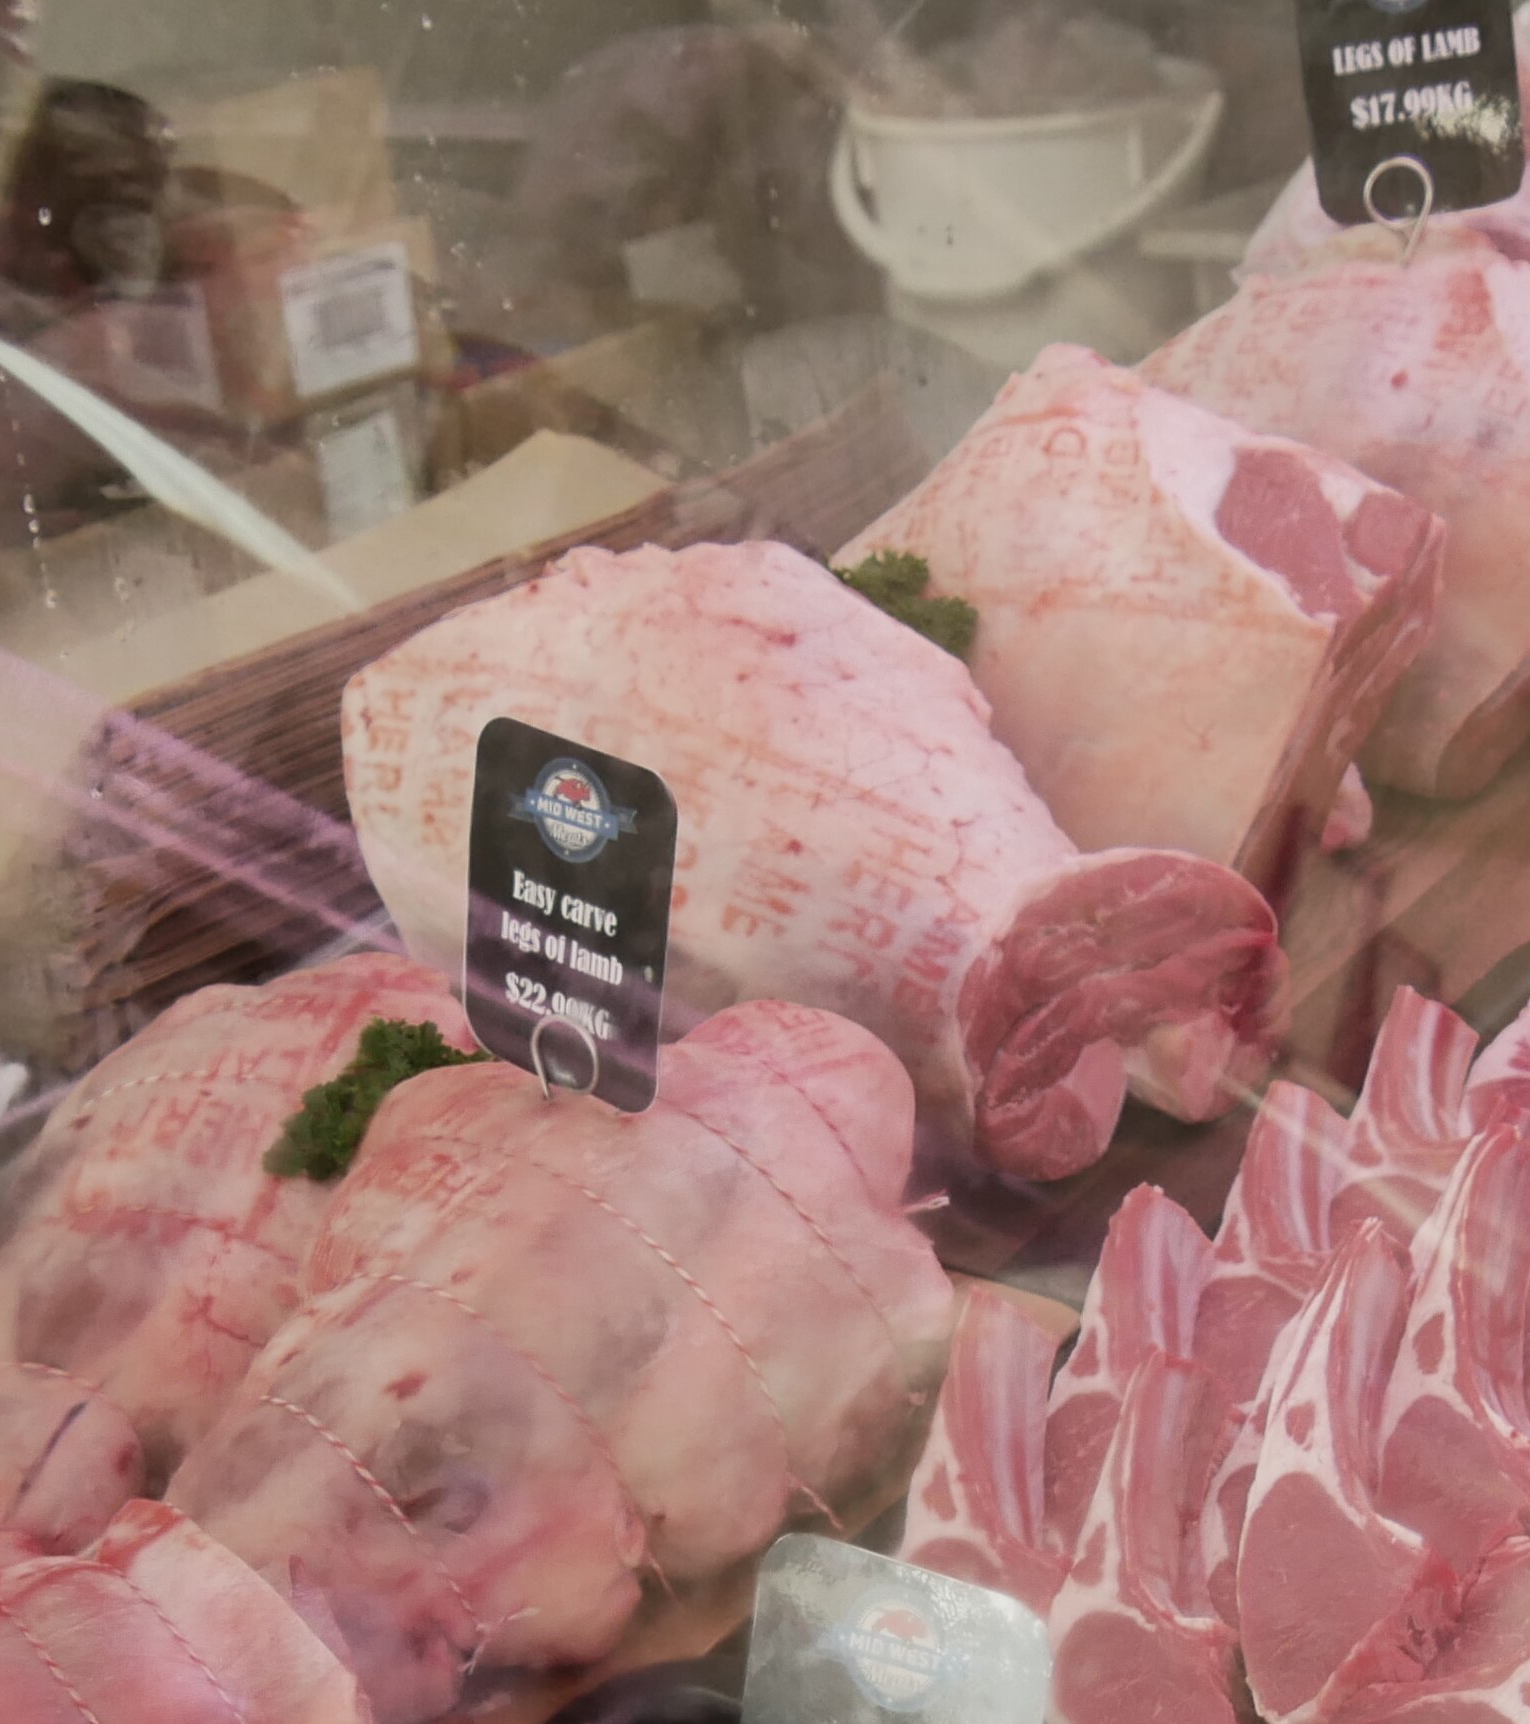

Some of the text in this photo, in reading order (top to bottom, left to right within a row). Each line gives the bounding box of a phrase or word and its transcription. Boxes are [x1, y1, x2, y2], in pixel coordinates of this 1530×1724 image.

[1332, 27, 1482, 77] LEGS OF LAMB
[1349, 80, 1475, 131] $17.99KG
[536, 797, 604, 829] MID WEST
[512, 870, 619, 938] Easy carve
[500, 910, 625, 987] legs of lamb
[849, 1631, 941, 1672] MID WEST
